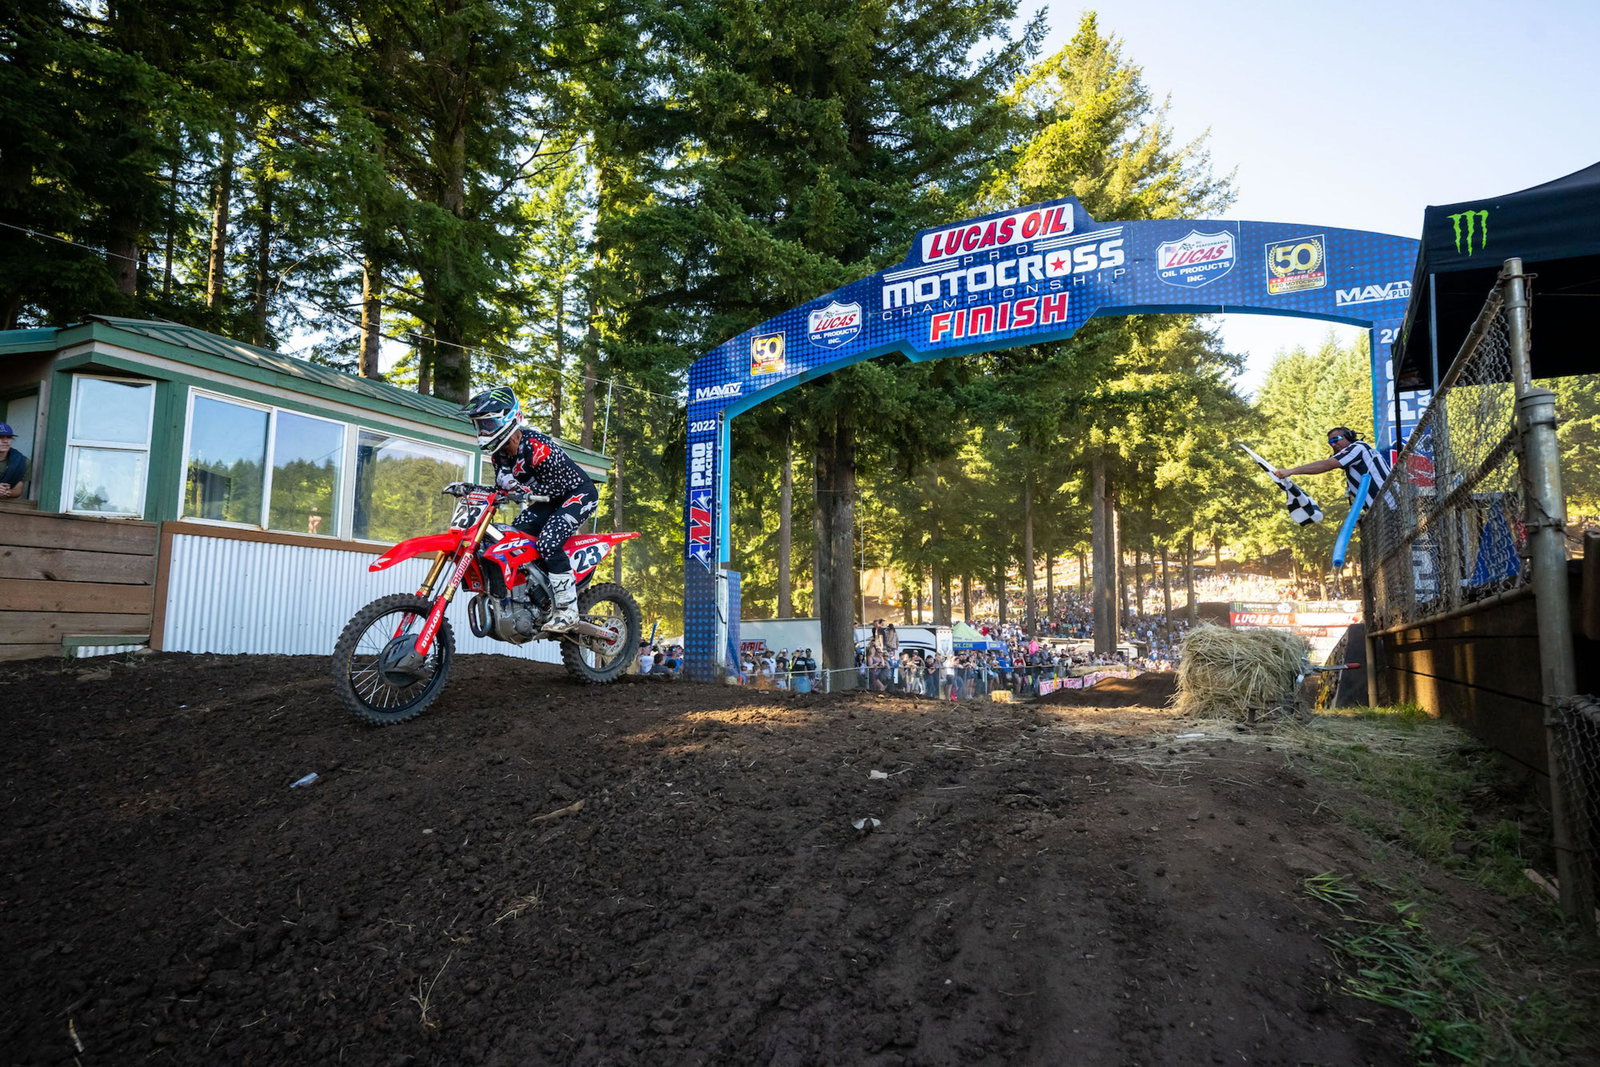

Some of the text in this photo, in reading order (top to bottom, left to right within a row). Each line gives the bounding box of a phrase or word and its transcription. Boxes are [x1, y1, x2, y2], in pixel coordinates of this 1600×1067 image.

[928, 207, 1067, 259] LUCAS OIL
[964, 244, 1028, 266] PRO
[1165, 245, 1228, 267] LUCAS
[1275, 243, 1318, 273] 50
[882, 239, 1125, 310] MOTOCROSS
[1162, 261, 1230, 278] OIL PRODUCTS
[1187, 274, 1206, 283] INC.
[882, 268, 1126, 320] CHAMPIONSHIP
[1392, 288, 1410, 298] PLU
[814, 313, 856, 331] LUCAS
[930, 291, 1069, 342] FINISH
[823, 327, 858, 338] PRODUCTS
[756, 337, 781, 360] 50
[696, 382, 743, 400] MAVTV
[690, 419, 716, 433] 2022
[691, 442, 706, 487] PRO
[705, 441, 714, 486] RACING
[451, 505, 481, 529] 23
[575, 537, 600, 546] HONDA
[574, 545, 602, 573] 23
[452, 555, 471, 588] SHOWA
[421, 609, 441, 648] DUNLOP
[1234, 613, 1270, 624] LUCAS
